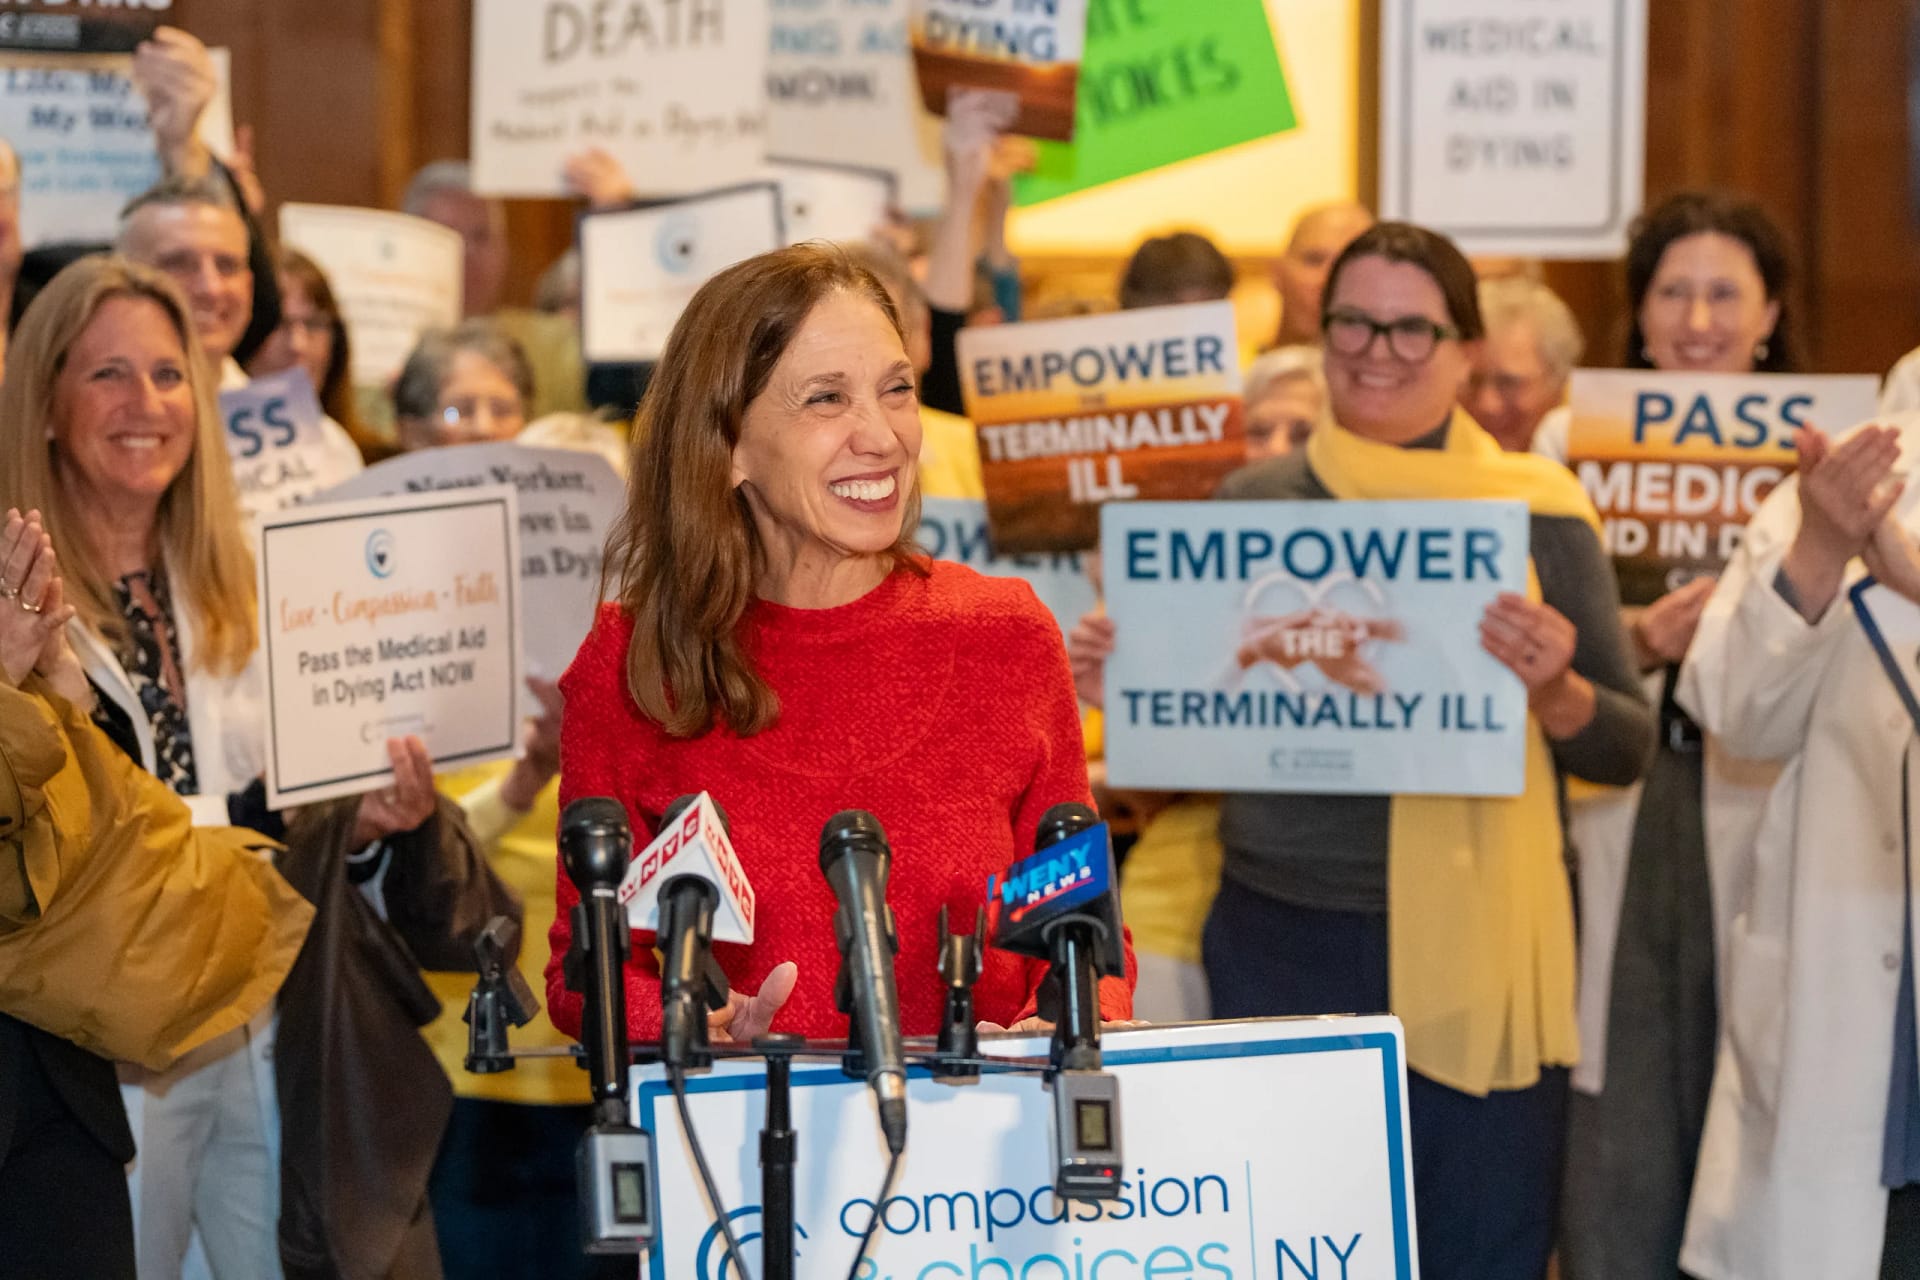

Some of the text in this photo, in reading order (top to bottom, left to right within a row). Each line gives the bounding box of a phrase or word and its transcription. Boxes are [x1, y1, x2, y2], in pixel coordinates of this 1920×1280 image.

[542, 0, 726, 66] DEATH
[926, 10, 1056, 60] DYING
[1423, 17, 1602, 57] MEDICAL
[1448, 74, 1577, 114] AID IN
[1445, 131, 1574, 174] DYING
[974, 335, 1225, 397] EMPOWER
[229, 396, 296, 458] SS
[980, 403, 1230, 461] TERMINALLY
[1632, 390, 1816, 449] PASS
[1067, 454, 1139, 503] ILL
[1576, 460, 1785, 516] MEDIC
[1126, 527, 1505, 581] EMPOWER
[1604, 516, 1649, 557] ID
[1657, 518, 1707, 559] IN
[298, 626, 487, 676] Pass the Medical Aid
[1280, 628, 1345, 658] THE
[312, 658, 477, 708] in Dying Act NOW
[1121, 688, 1507, 732] TERMINALLY ILL
[1001, 841, 1092, 904] WENY
[1027, 866, 1091, 905] NEWS
[1275, 1233, 1363, 1280] NY
